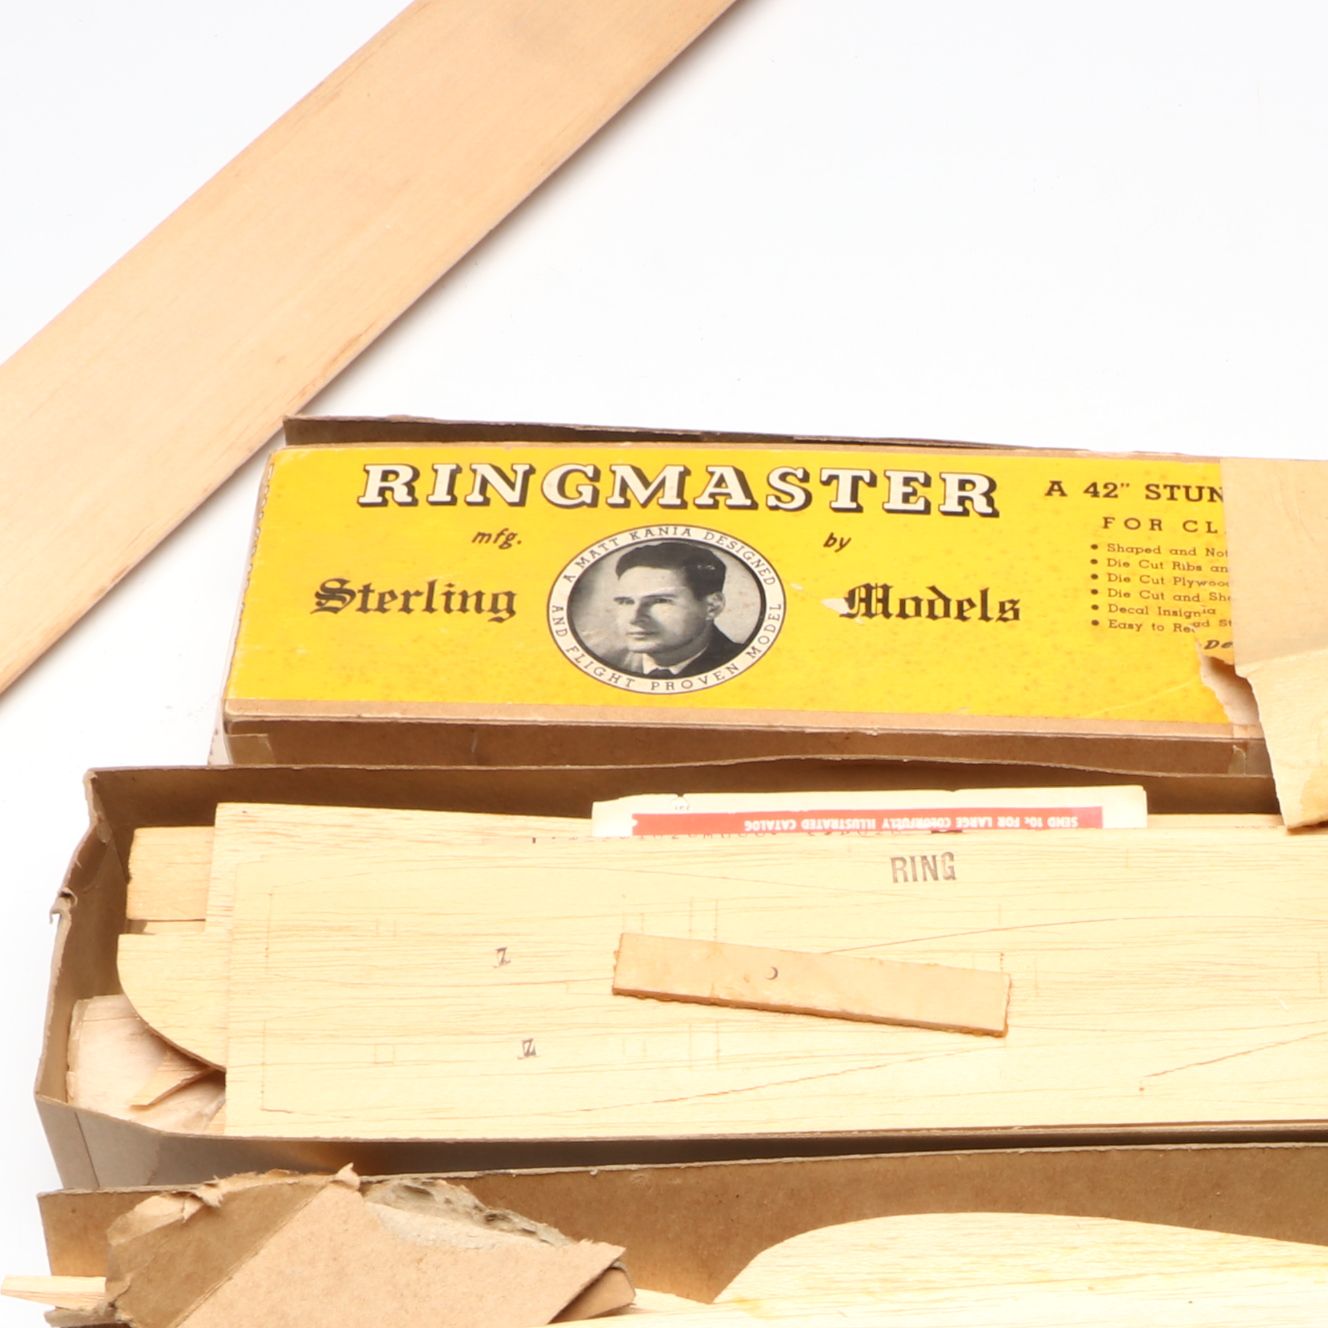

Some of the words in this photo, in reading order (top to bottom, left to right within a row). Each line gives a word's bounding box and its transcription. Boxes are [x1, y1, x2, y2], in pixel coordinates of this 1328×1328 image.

[357, 463, 1001, 517] RINGMASTER
[1044, 480, 1068, 497] A
[1083, 481, 1130, 498] 42"
[1102, 516, 1163, 532] FOR
[471, 528, 523, 550] mfg.
[823, 532, 852, 553] by
[562, 573, 577, 583] A
[575, 538, 619, 569] MATT
[629, 526, 692, 540] KANIA
[703, 531, 776, 586] DESIGNED
[1107, 543, 1161, 556] Shaped
[1169, 547, 1197, 557] and
[1107, 558, 1130, 568] Die
[1138, 559, 1164, 570] Cut
[1172, 561, 1203, 572] Ribs
[1107, 573, 1131, 583] Die
[1139, 575, 1165, 585] Cut
[311, 577, 517, 622] Sterling
[839, 582, 1022, 623] Models
[1107, 588, 1131, 598] Die
[1139, 590, 1165, 600] Cut
[1173, 593, 1200, 603] and
[1108, 604, 1149, 615] Decal
[1157, 605, 1216, 619] Insignia
[1108, 619, 1143, 632] Easy
[1151, 621, 1164, 632] to
[552, 605, 568, 638] AND
[566, 646, 636, 688] FLIGHT
[651, 663, 739, 691] PROVEN
[746, 603, 782, 660] MODEL
[744, 819, 796, 832] CATALOG
[956, 817, 995, 830] LARGE
[998, 817, 1020, 829] FOR
[1047, 815, 1079, 829] SEND
[890, 851, 957, 883] RING
